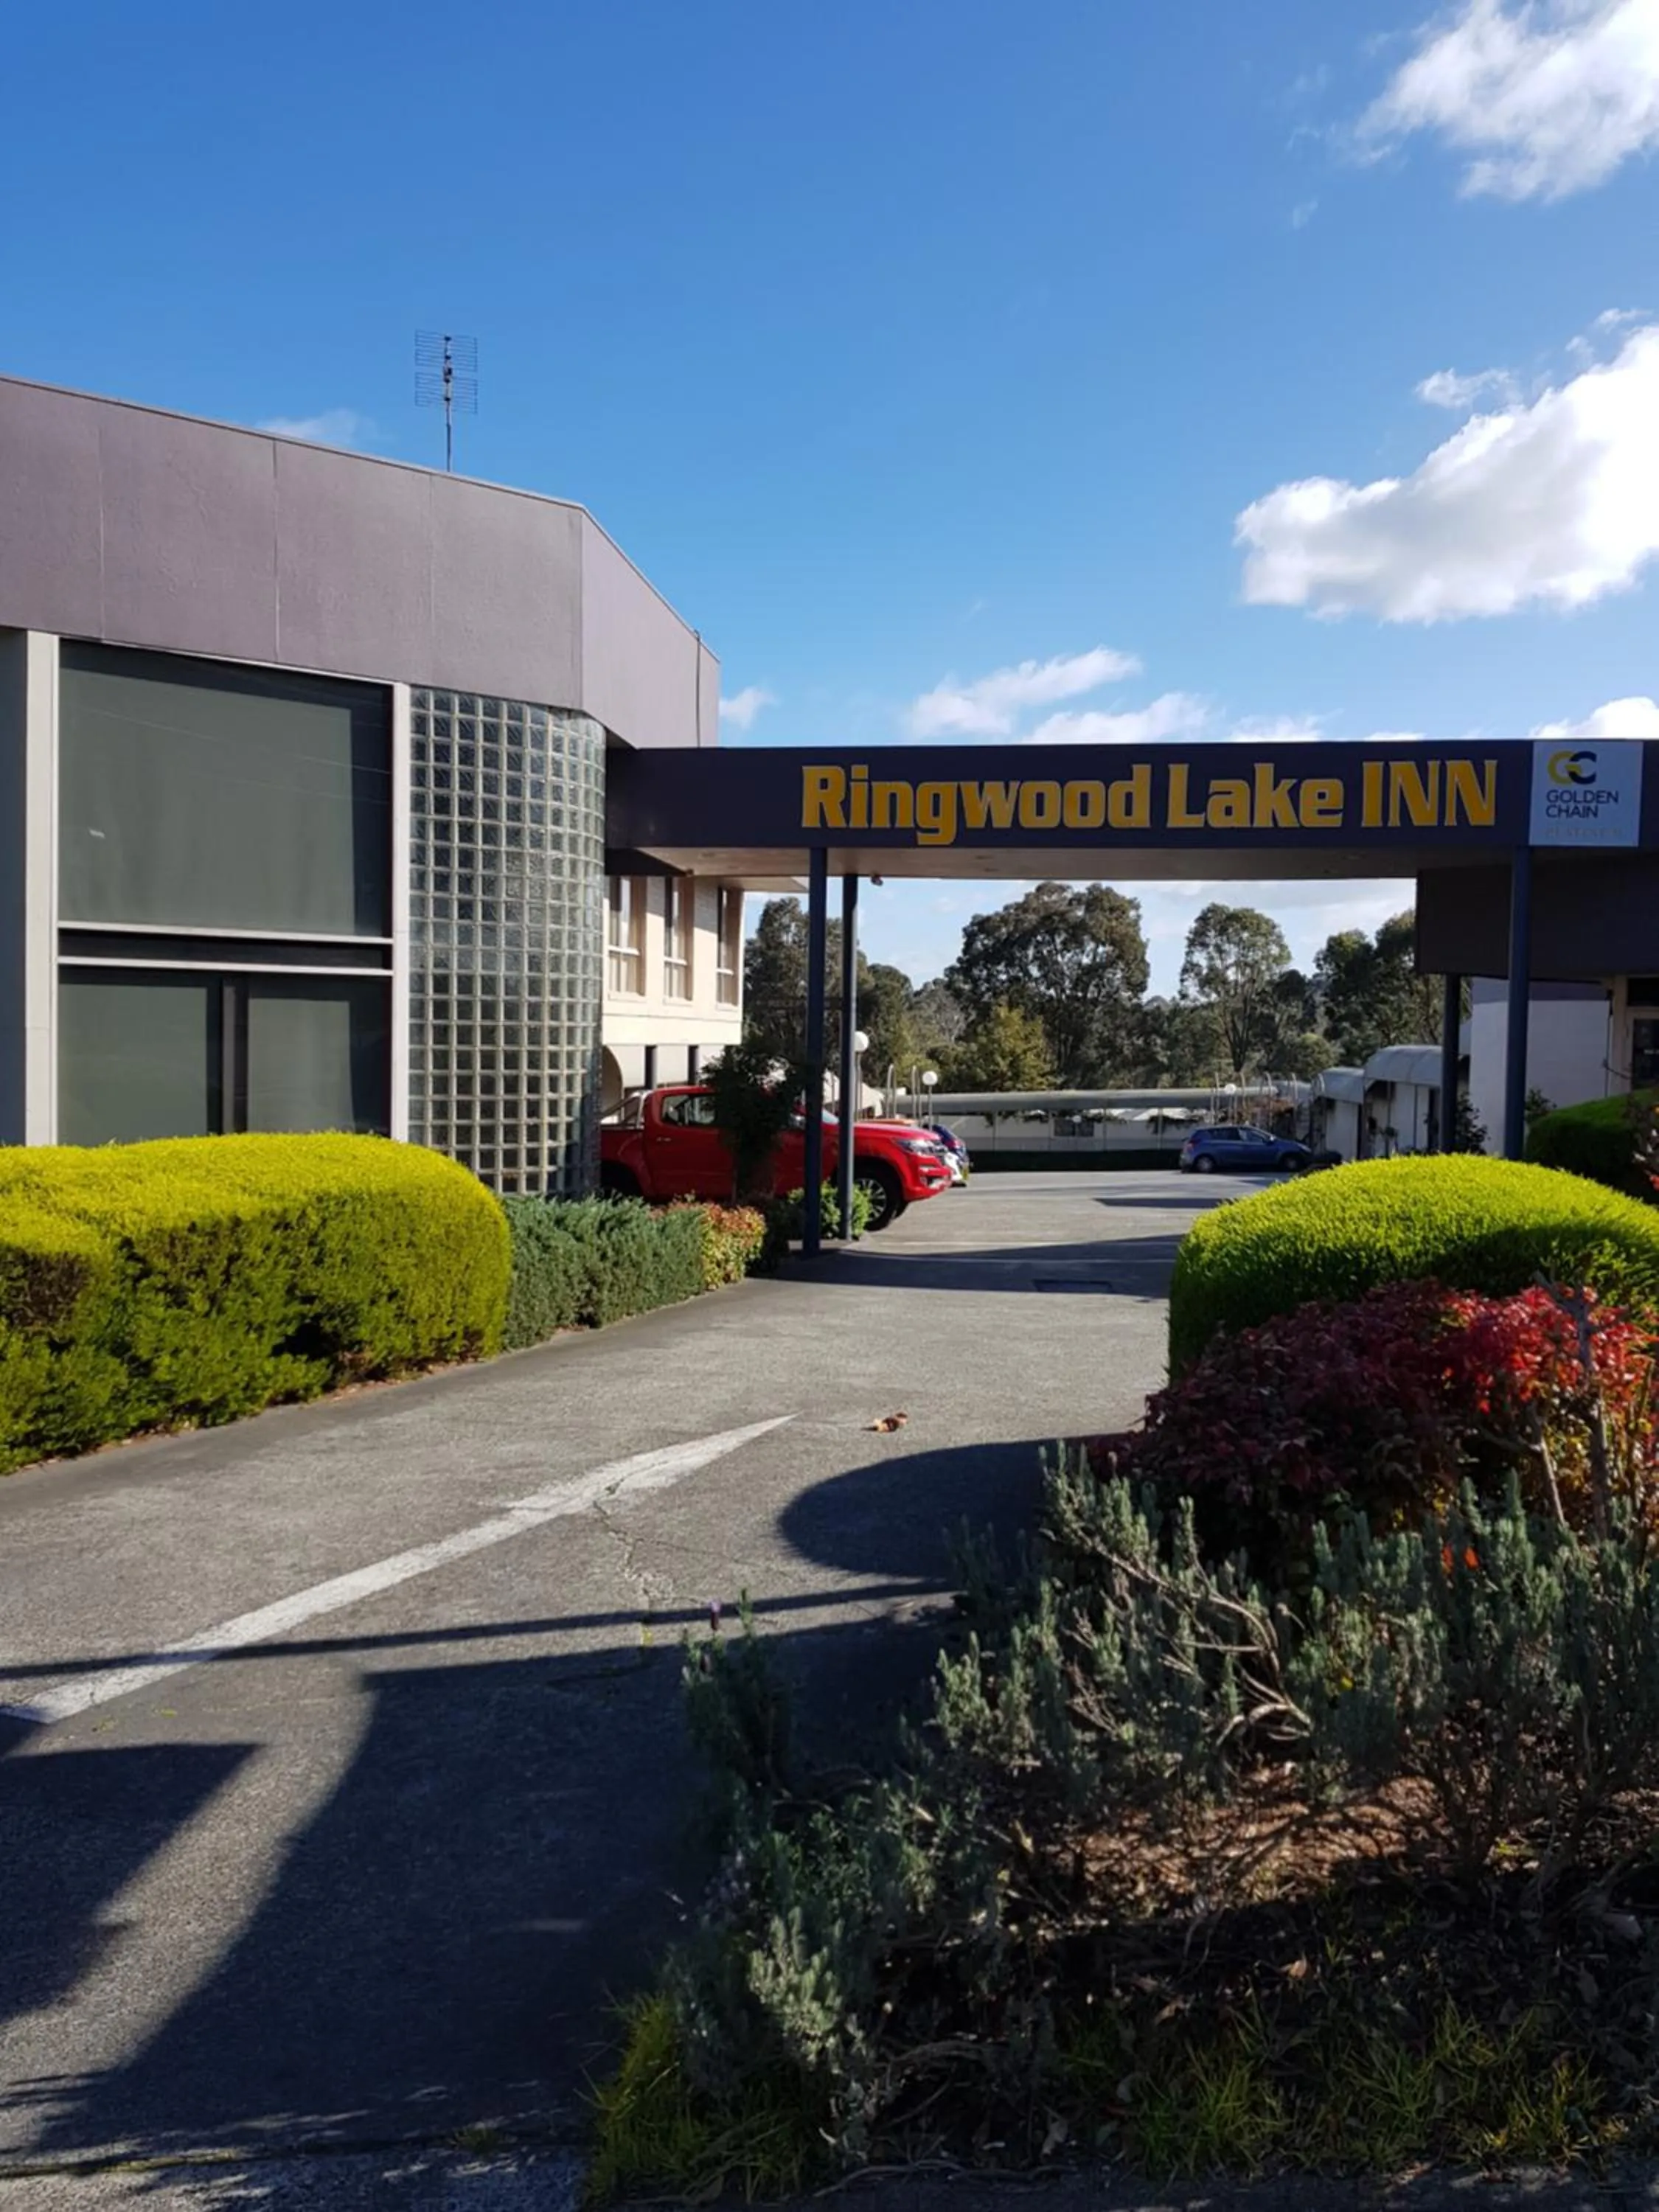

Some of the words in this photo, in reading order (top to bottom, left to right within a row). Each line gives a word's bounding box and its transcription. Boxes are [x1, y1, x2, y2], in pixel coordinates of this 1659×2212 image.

[801, 764, 1152, 846] Ringwood
[1166, 762, 1345, 828] Lake
[1361, 759, 1498, 827] INN
[1546, 789, 1619, 804] GOLDEN
[1545, 804, 1599, 818] CHAIN
